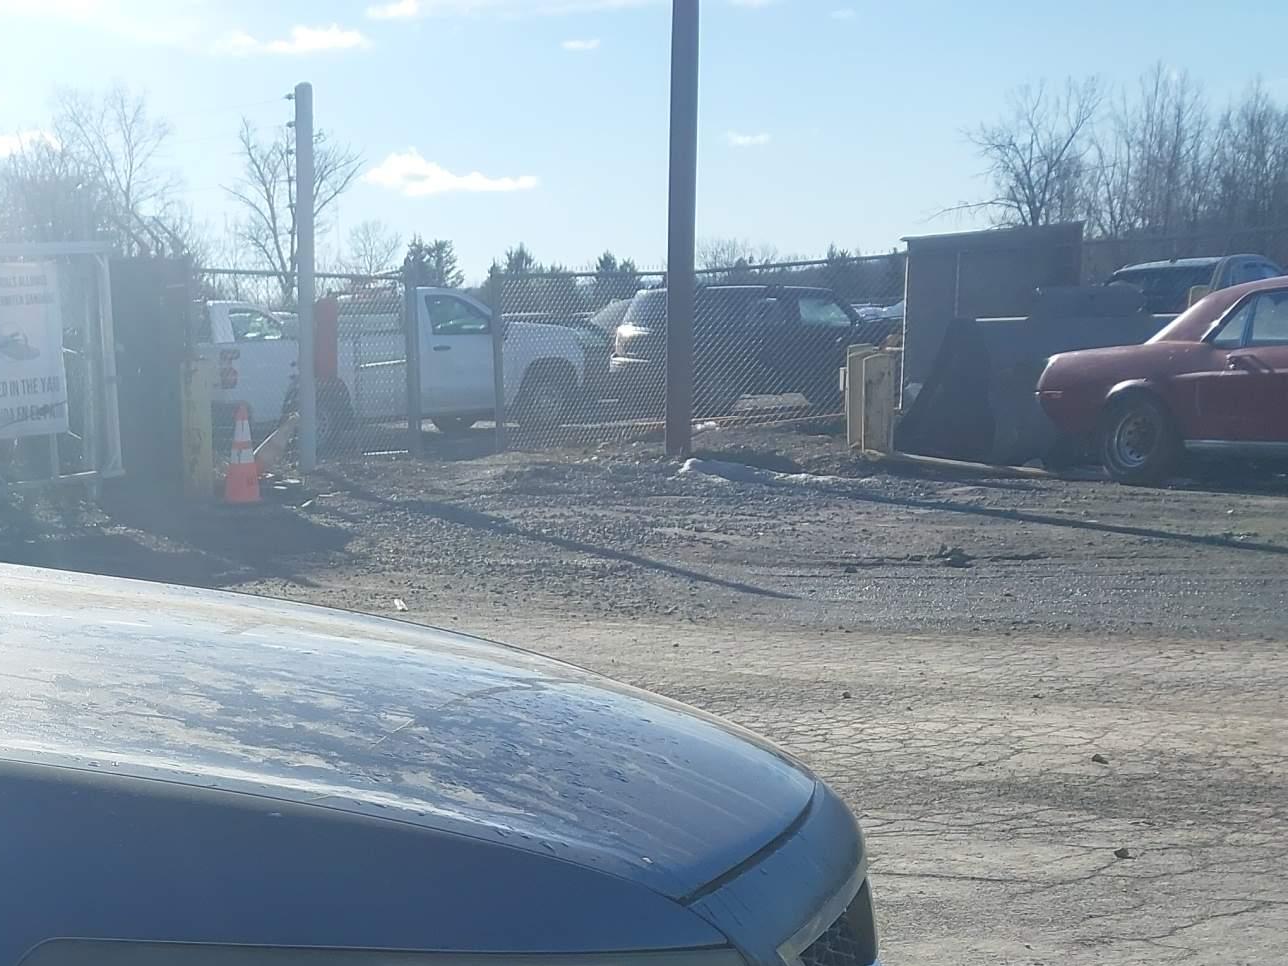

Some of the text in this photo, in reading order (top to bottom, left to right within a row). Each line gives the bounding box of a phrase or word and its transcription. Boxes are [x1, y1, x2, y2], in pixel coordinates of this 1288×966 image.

[9, 379, 21, 397] IN
[21, 377, 39, 394] THE
[40, 375, 62, 392] YAR
